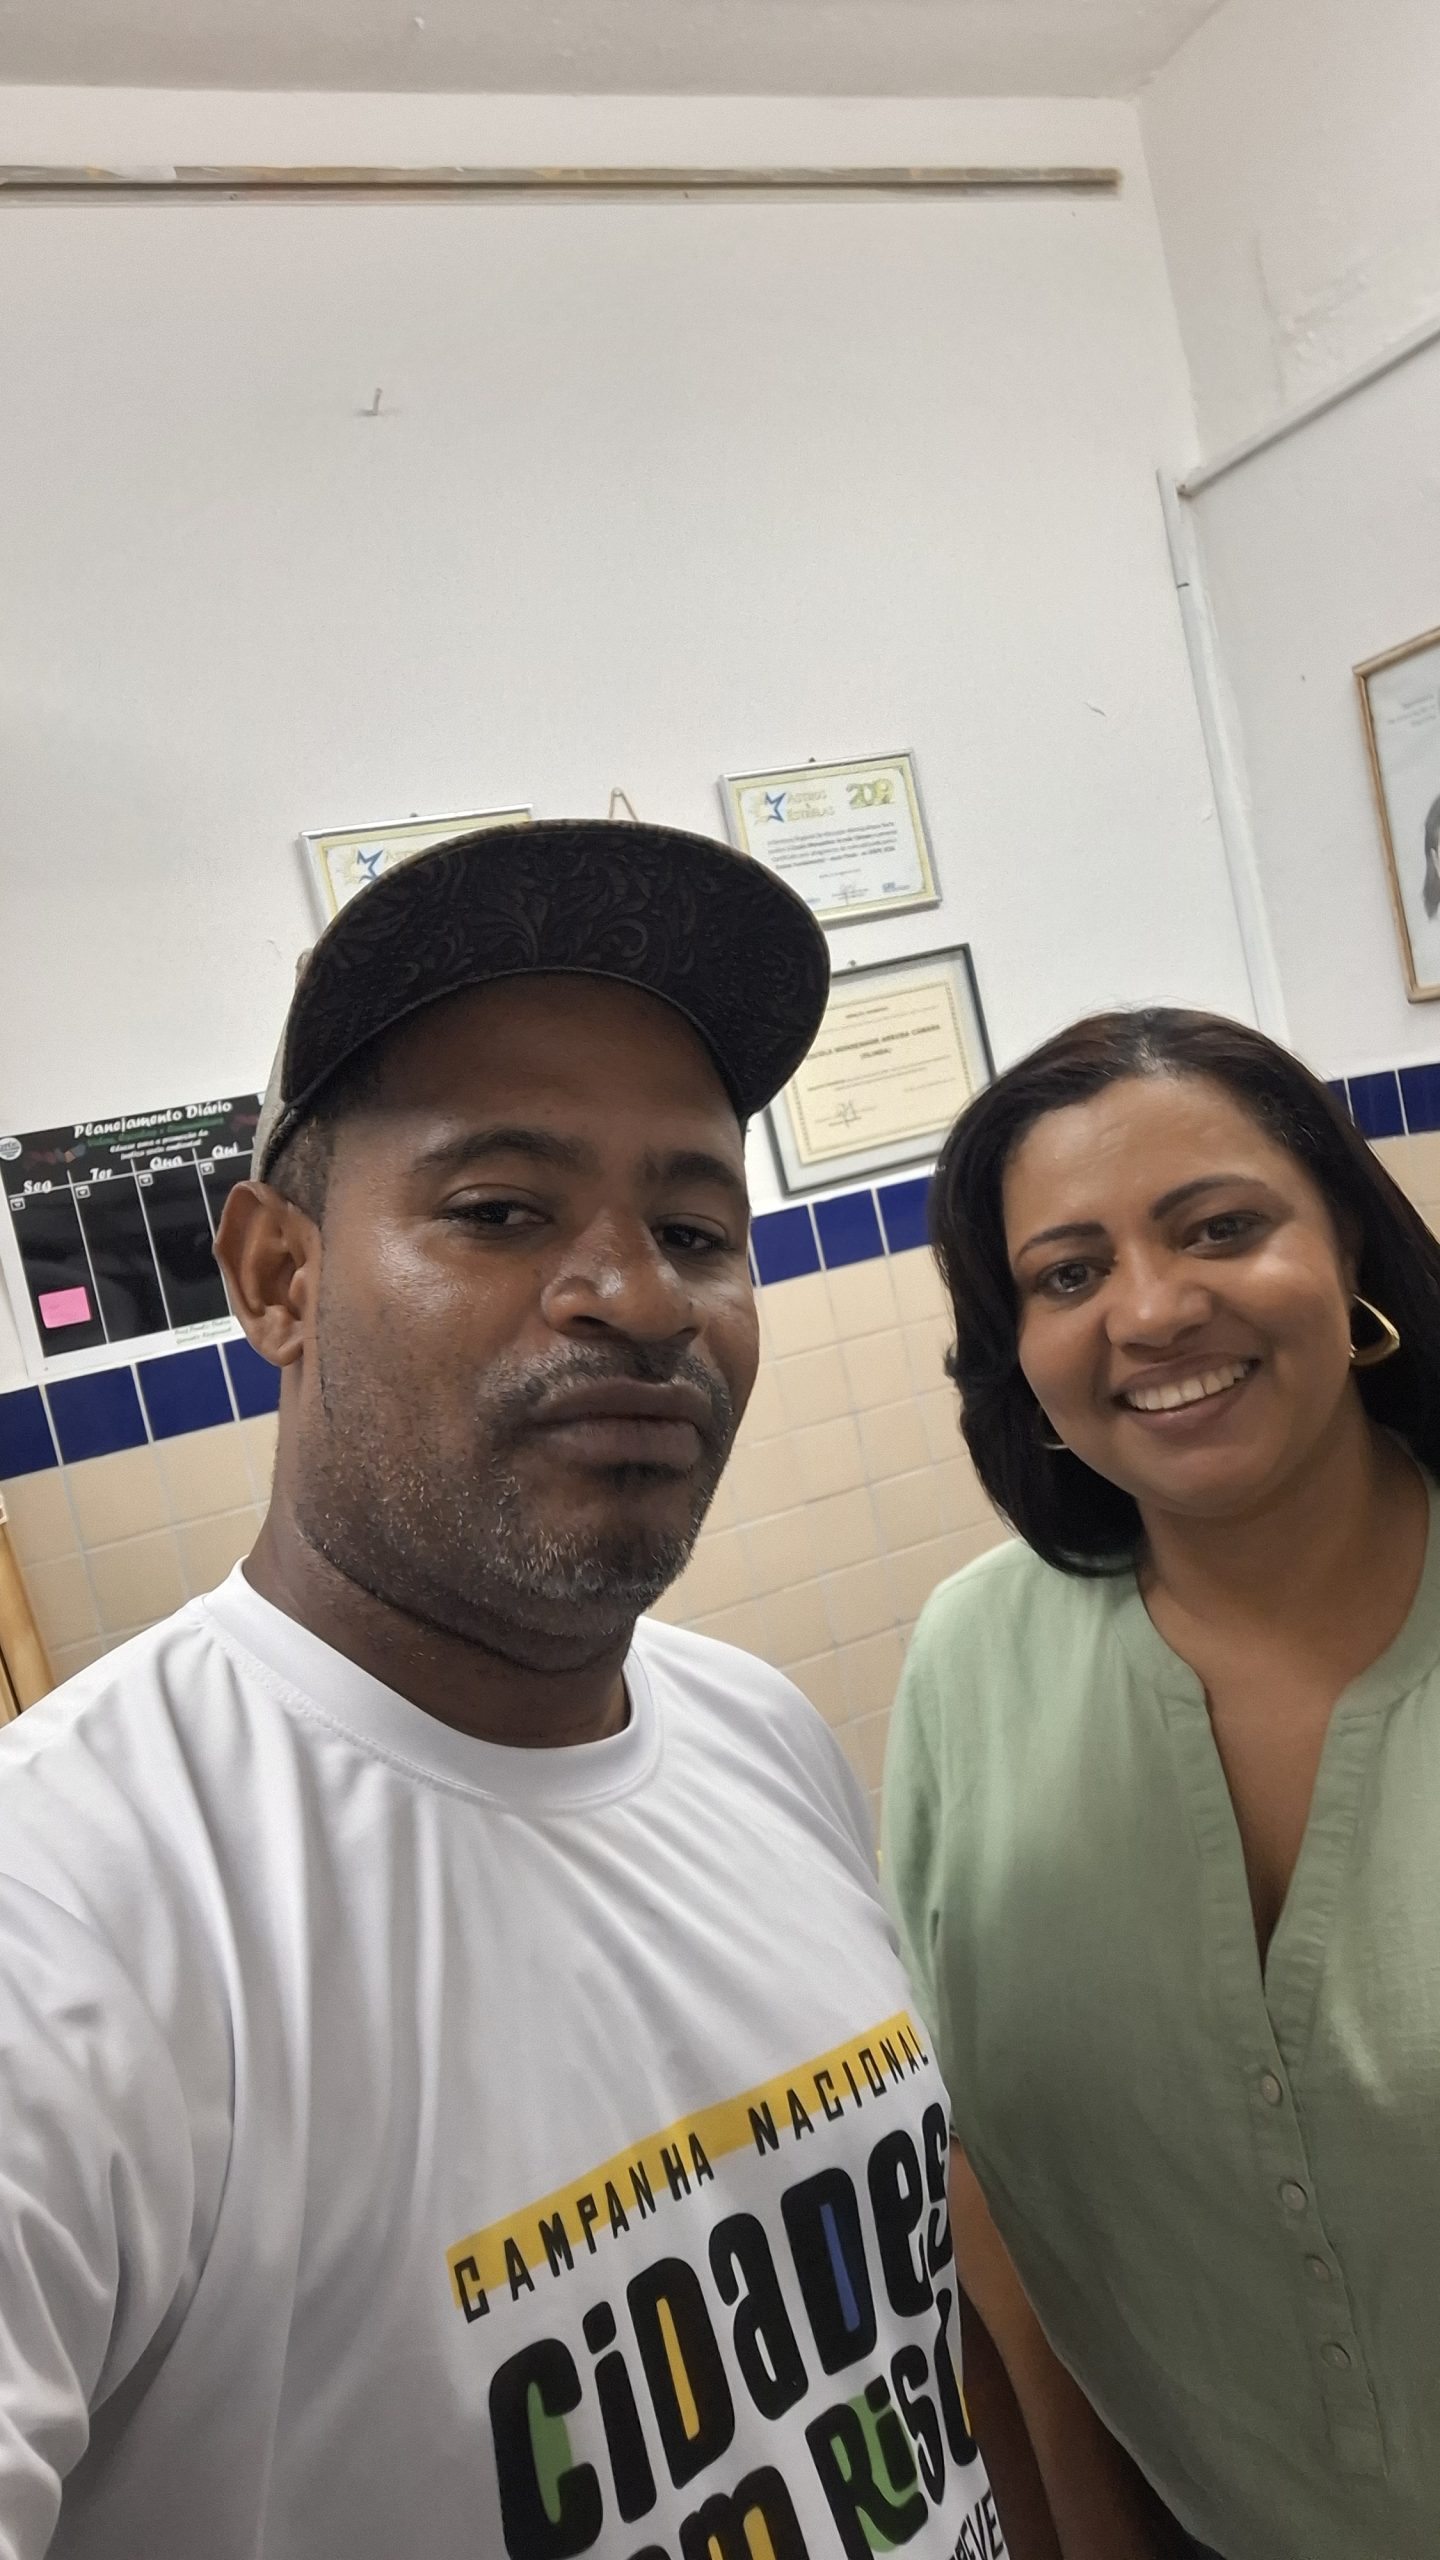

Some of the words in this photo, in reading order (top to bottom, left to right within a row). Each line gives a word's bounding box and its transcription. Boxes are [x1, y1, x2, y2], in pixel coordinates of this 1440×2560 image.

[73, 1110, 182, 1139] Planejamento
[185, 1101, 233, 1119] Diário
[90, 1167, 113, 1180] Ter
[150, 1155, 183, 1171] Qua
[211, 1142, 239, 1157] Qui
[454, 2132, 714, 2324] CAMPANHA
[747, 2025, 929, 2157] NACIONAL
